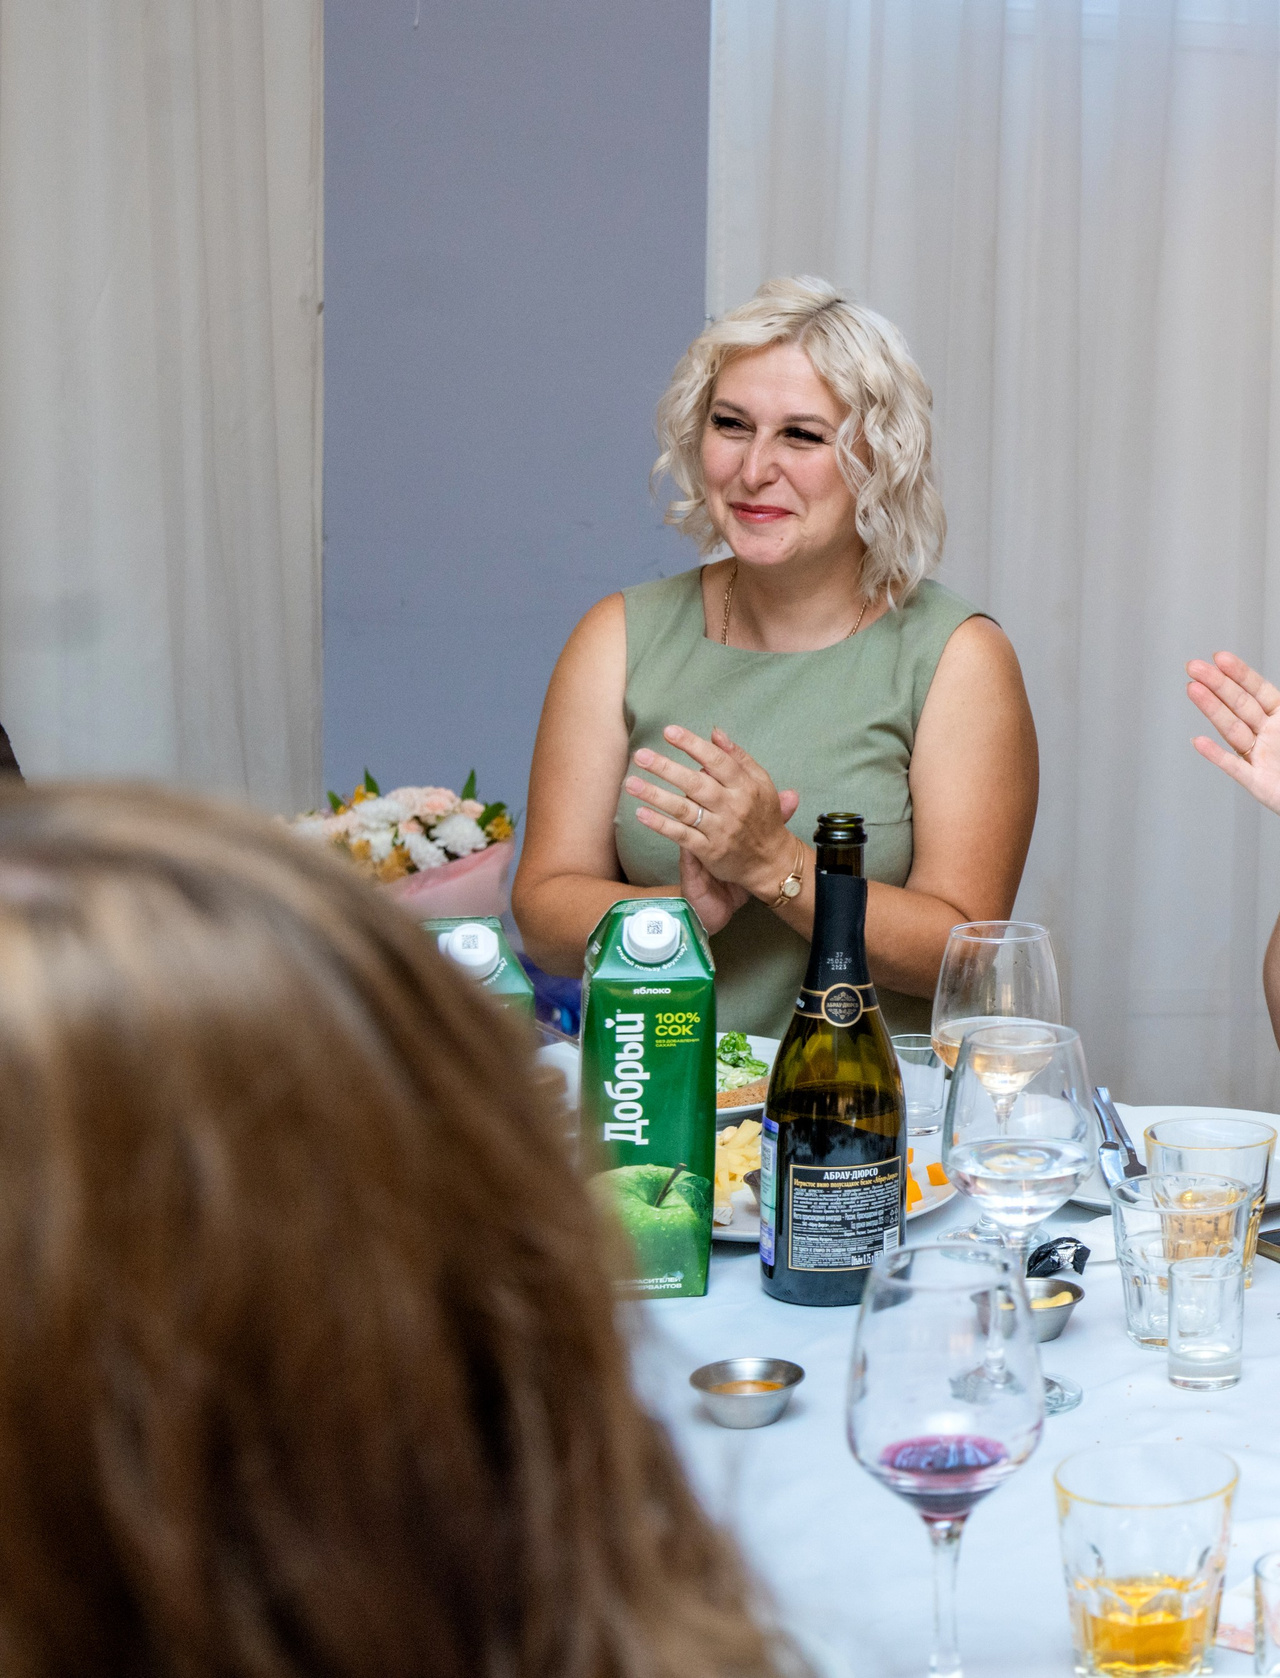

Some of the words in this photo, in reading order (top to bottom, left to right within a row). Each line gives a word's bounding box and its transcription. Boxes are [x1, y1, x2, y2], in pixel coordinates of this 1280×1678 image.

[633, 986, 672, 995] яблоко
[655, 1012, 701, 1024] 100%
[655, 1025, 694, 1036] СОК
[604, 1013, 650, 1145] Добрый
[823, 1167, 879, 1180] АБРАУ-ДЮРСО
